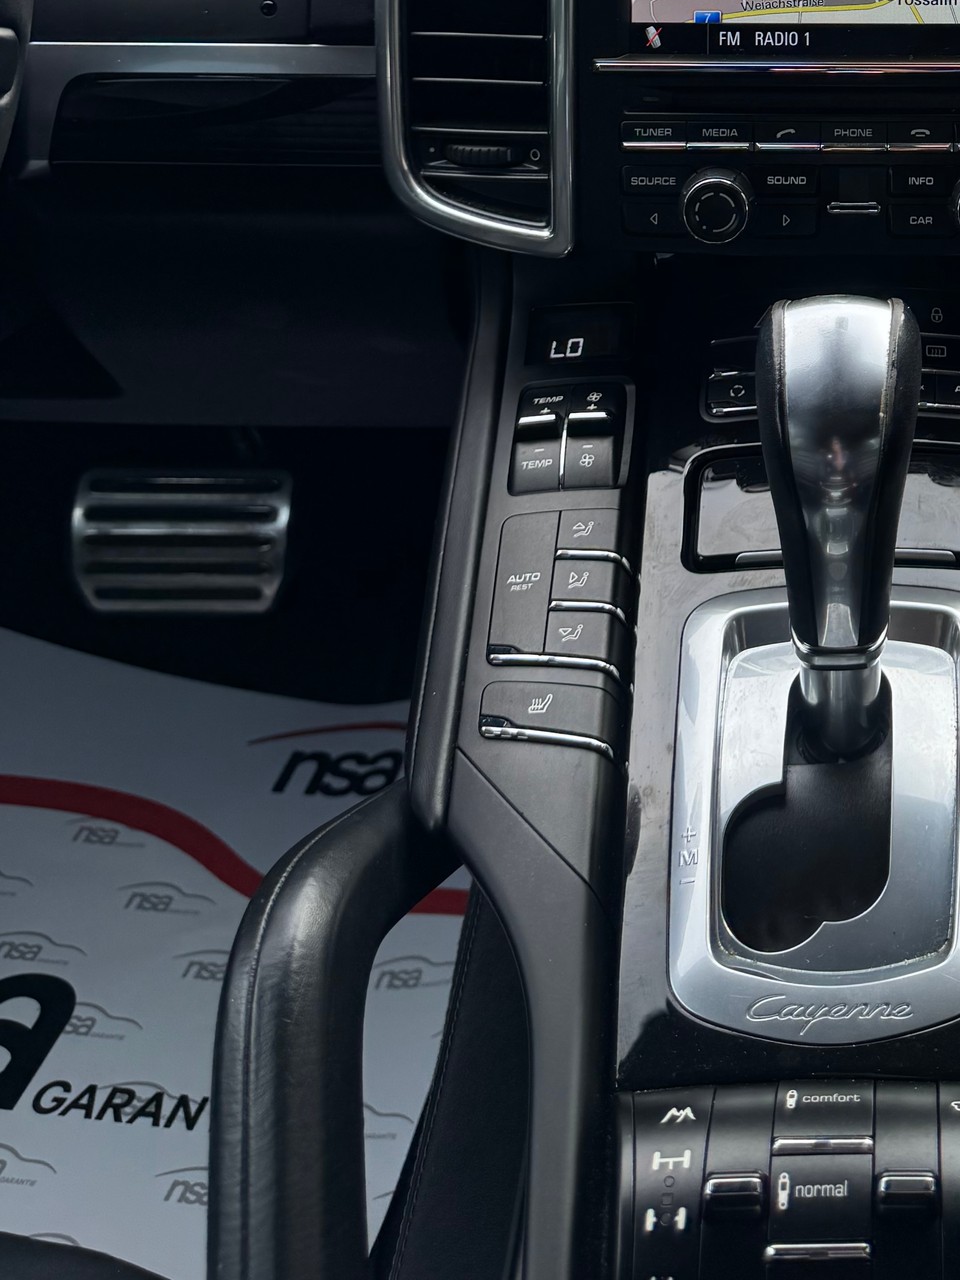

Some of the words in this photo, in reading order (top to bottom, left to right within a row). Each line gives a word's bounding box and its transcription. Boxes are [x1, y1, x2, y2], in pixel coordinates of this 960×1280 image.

[719, 31, 741, 46] FM
[755, 31, 798, 46] RADIO
[804, 31, 810, 46] 1
[634, 127, 672, 137] TUNER
[702, 128, 738, 137] MEDIA
[834, 128, 873, 138] PHONE
[630, 176, 676, 186] SOURCE
[767, 175, 807, 185] SOUND
[908, 176, 934, 186] INFO
[909, 215, 933, 225] CAR
[533, 395, 564, 404] TEMP
[521, 458, 553, 470] TEMP
[506, 572, 541, 584] AUTO
[510, 583, 533, 592] REST
[272, 749, 403, 796] nsa
[679, 850, 699, 866] M
[745, 994, 914, 1035] Cayenne
[802, 1092, 861, 1103] comfort
[795, 1180, 849, 1198] normal
